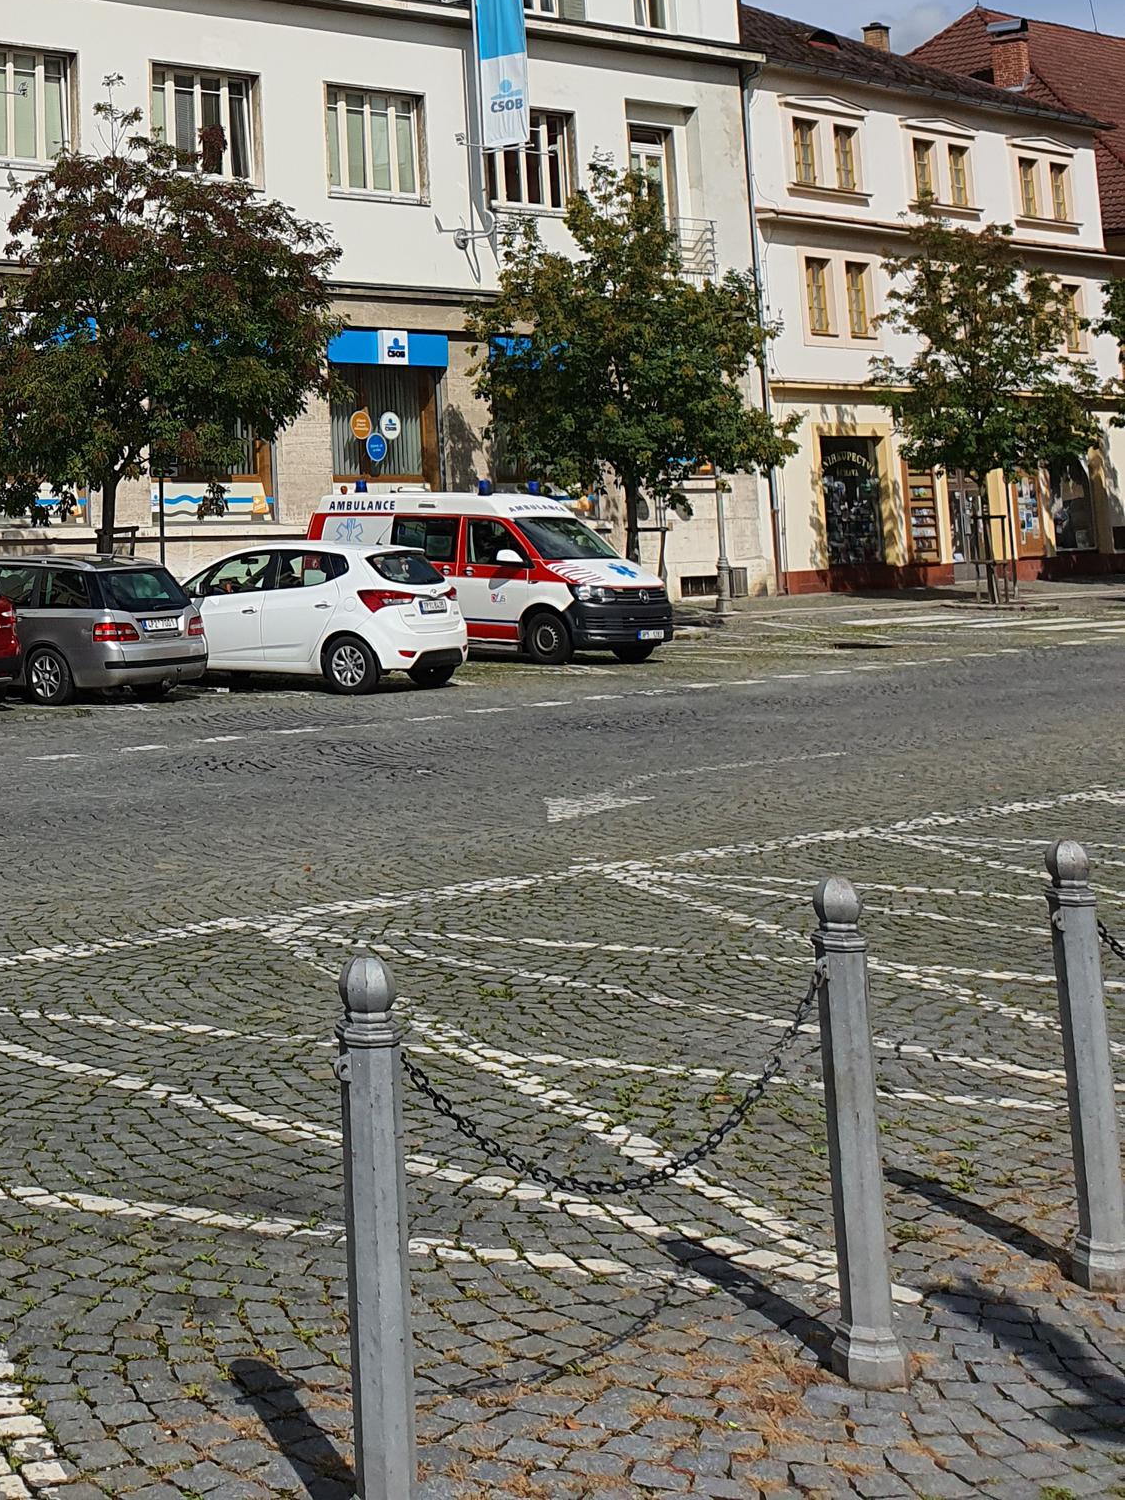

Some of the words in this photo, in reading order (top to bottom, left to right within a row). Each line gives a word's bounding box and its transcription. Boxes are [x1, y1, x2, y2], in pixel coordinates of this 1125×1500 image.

[491, 98, 524, 113] ČSOB
[387, 349, 406, 358] ČSOB
[329, 501, 396, 511] AMBULANCE
